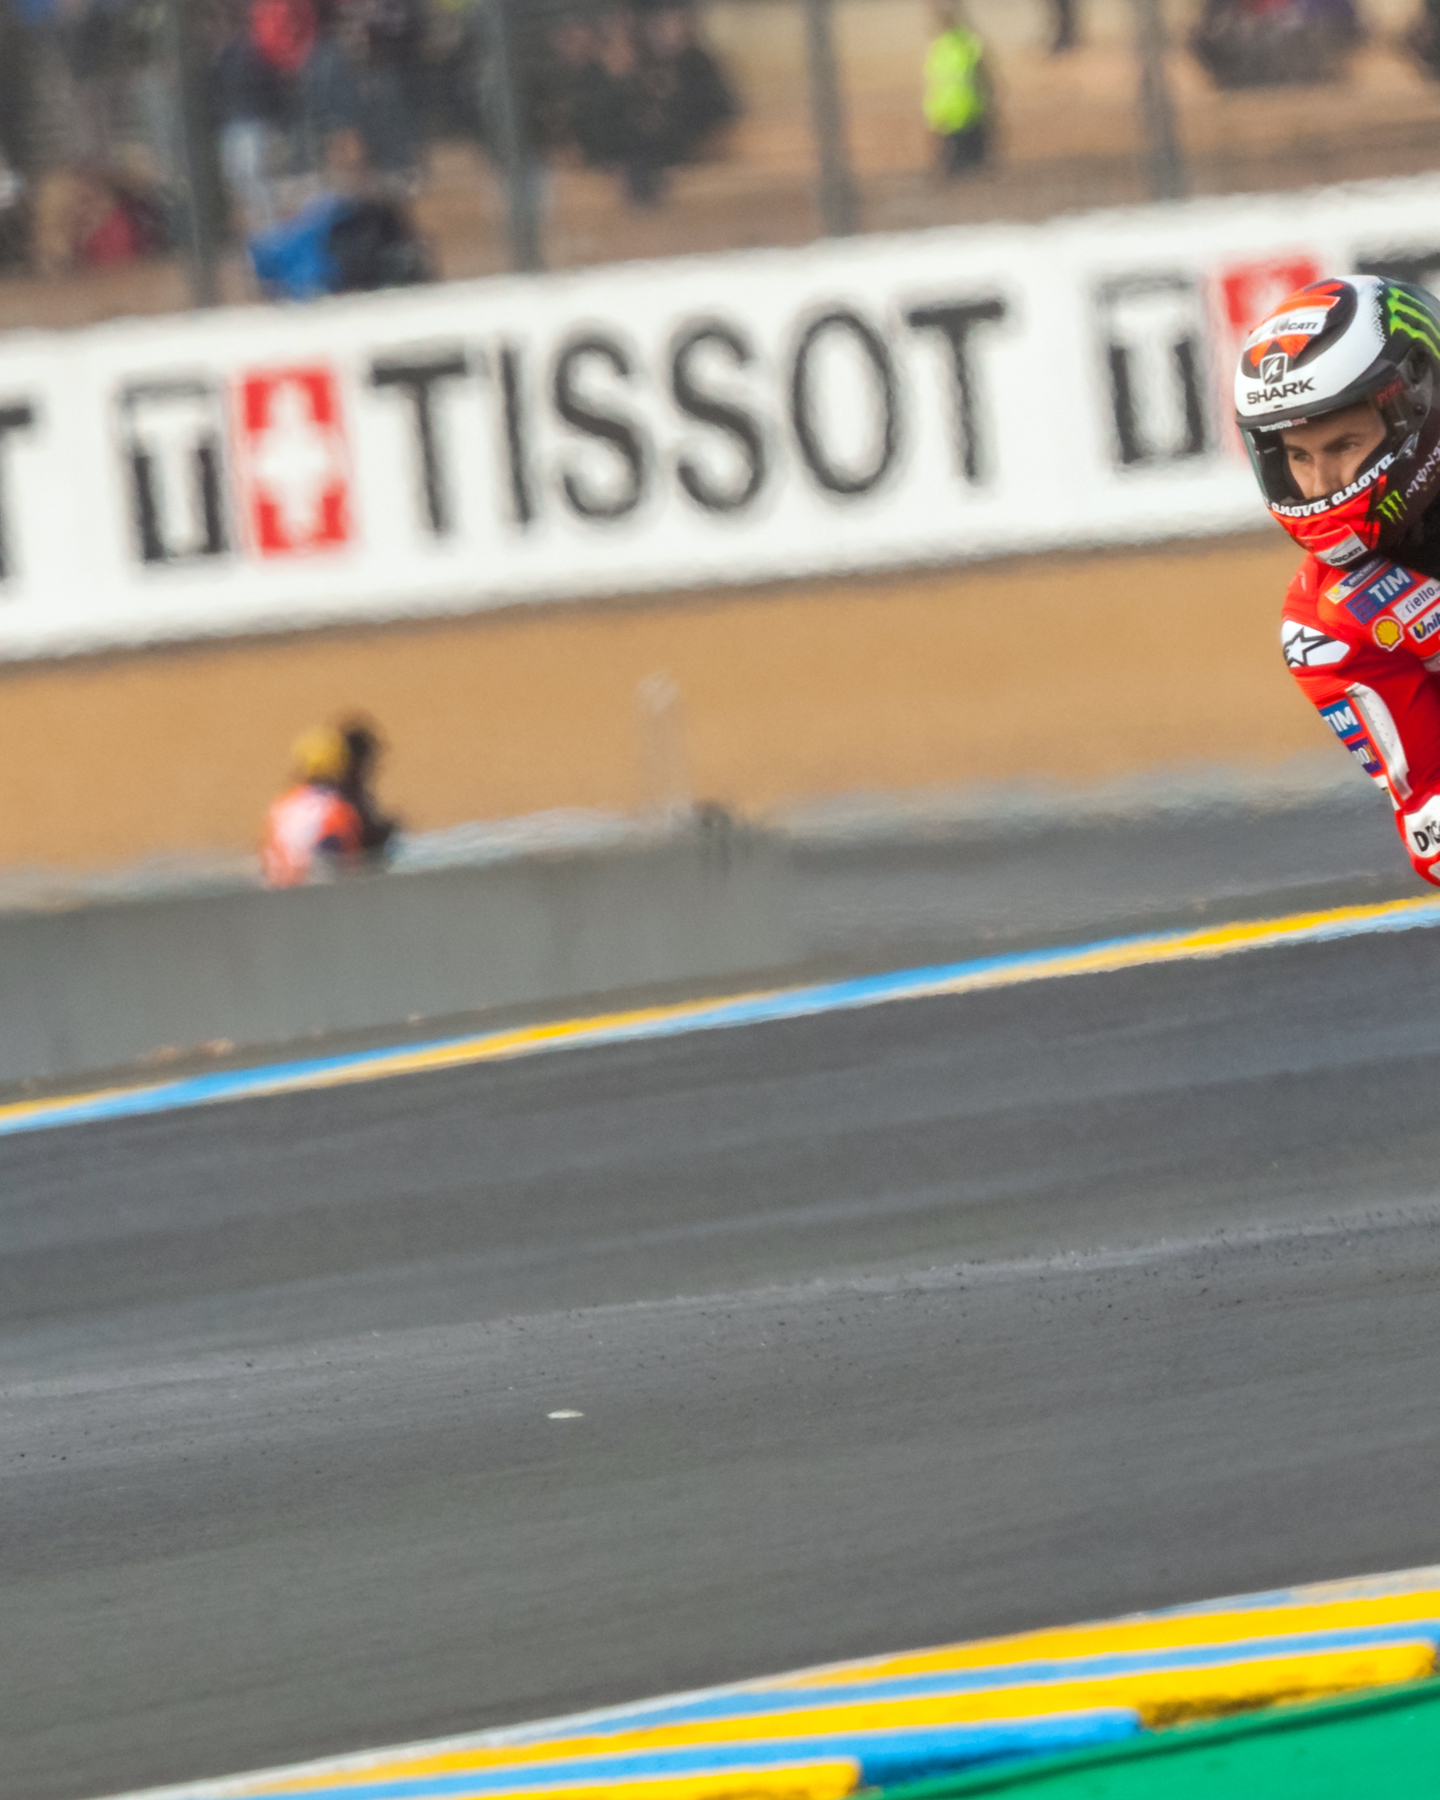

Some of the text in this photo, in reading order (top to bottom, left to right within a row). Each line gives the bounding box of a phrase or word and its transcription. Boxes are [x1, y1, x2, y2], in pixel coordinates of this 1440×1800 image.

[1246, 377, 1316, 405] SHARK
[370, 299, 1005, 534] TISSOT
[1367, 566, 1412, 603] TIM
[1405, 585, 1436, 615] riello
[1323, 706, 1359, 734] TIM
